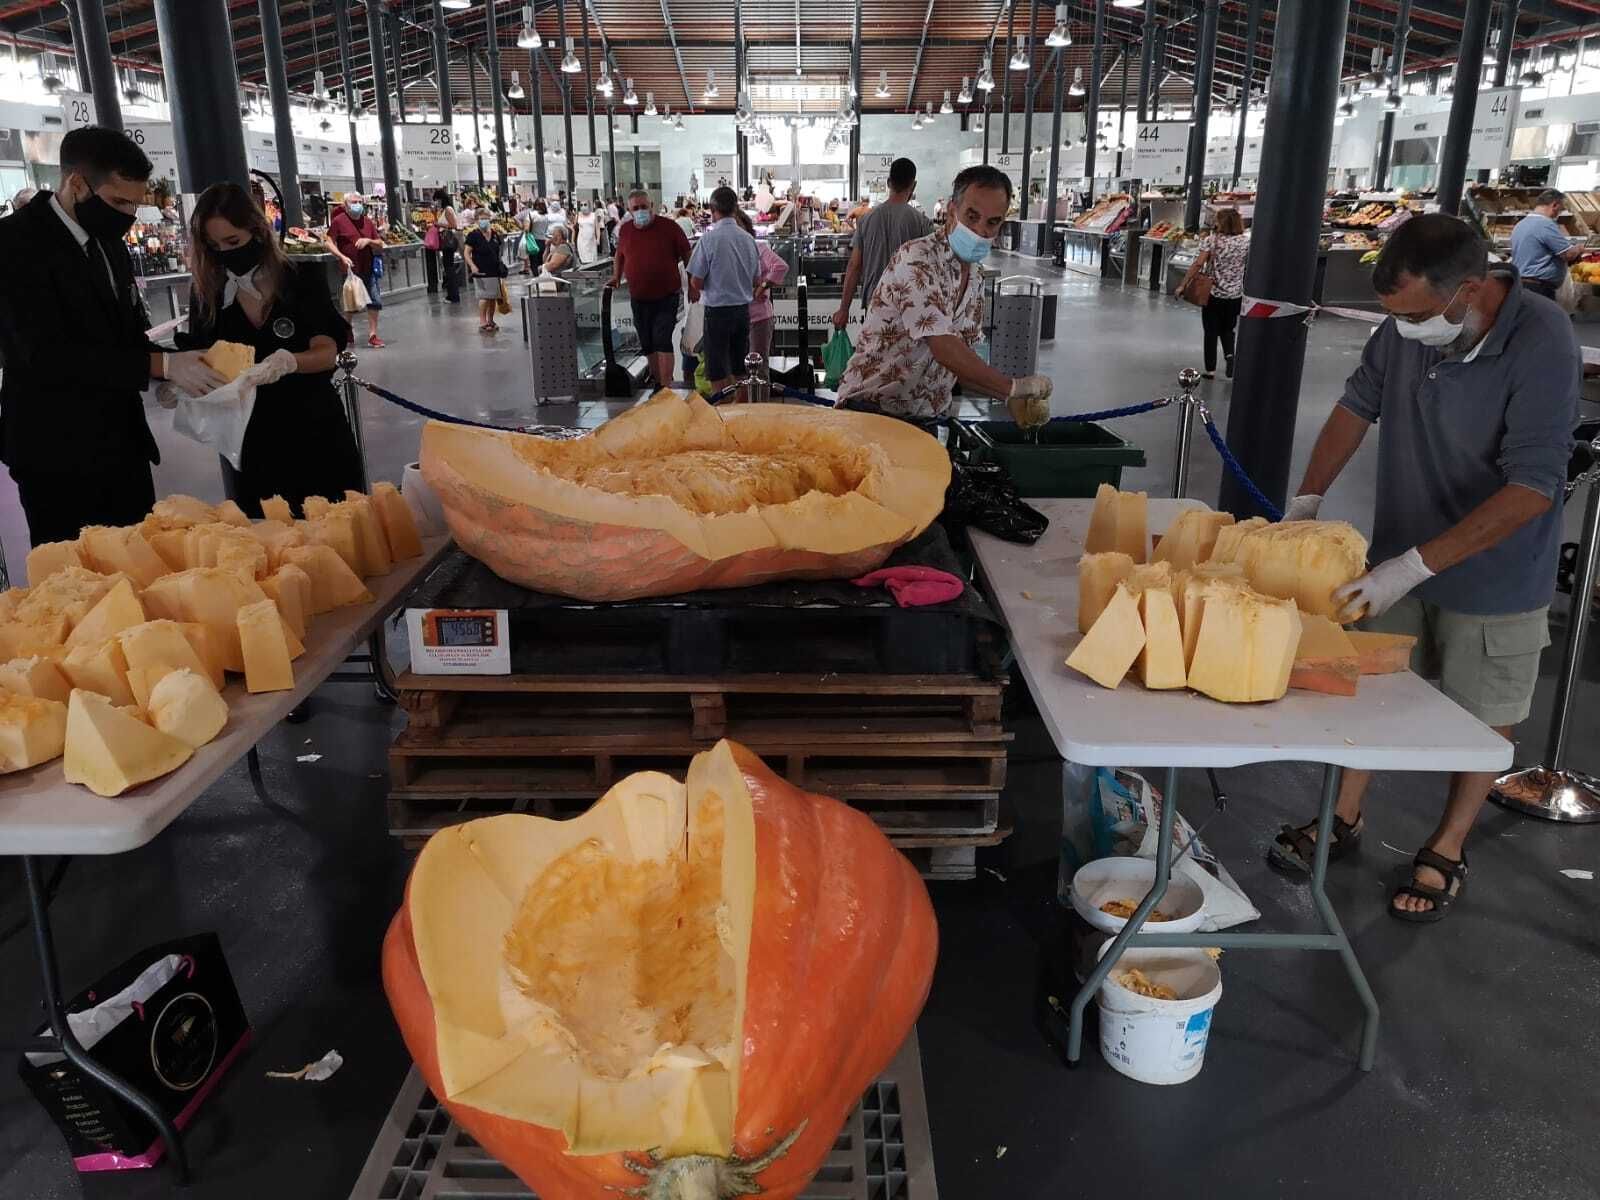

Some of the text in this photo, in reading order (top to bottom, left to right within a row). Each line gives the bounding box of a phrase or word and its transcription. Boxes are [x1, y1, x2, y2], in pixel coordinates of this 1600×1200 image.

[72, 100, 89, 122] 28
[1491, 95, 1507, 116] 44
[430, 128, 451, 144] 28
[1138, 126, 1160, 141] 44
[588, 158, 600, 168] 32
[704, 158, 717, 168] 36
[998, 156, 1010, 166] 48
